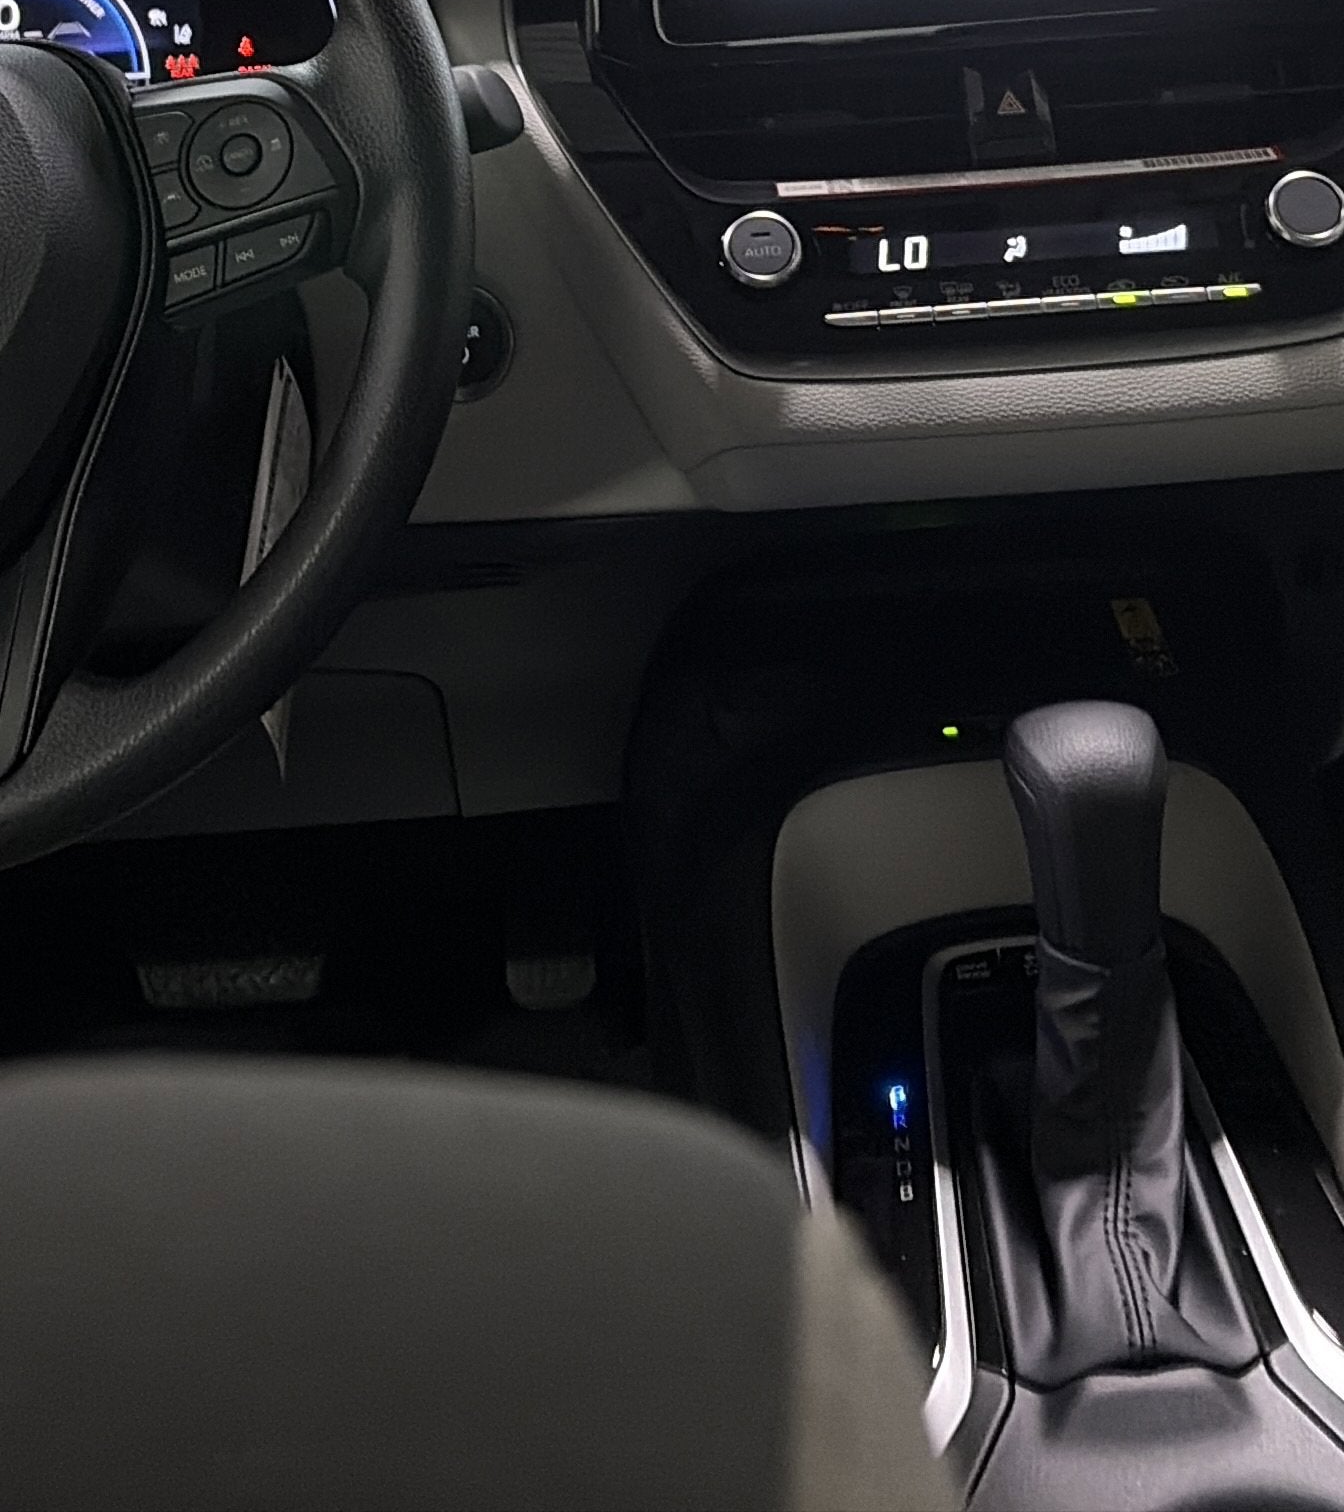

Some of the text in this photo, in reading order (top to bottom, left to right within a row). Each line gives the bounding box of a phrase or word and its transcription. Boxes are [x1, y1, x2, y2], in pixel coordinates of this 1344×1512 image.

[744, 245, 782, 257] AUTO
[878, 235, 928, 272] LO
[174, 265, 207, 284] MODE
